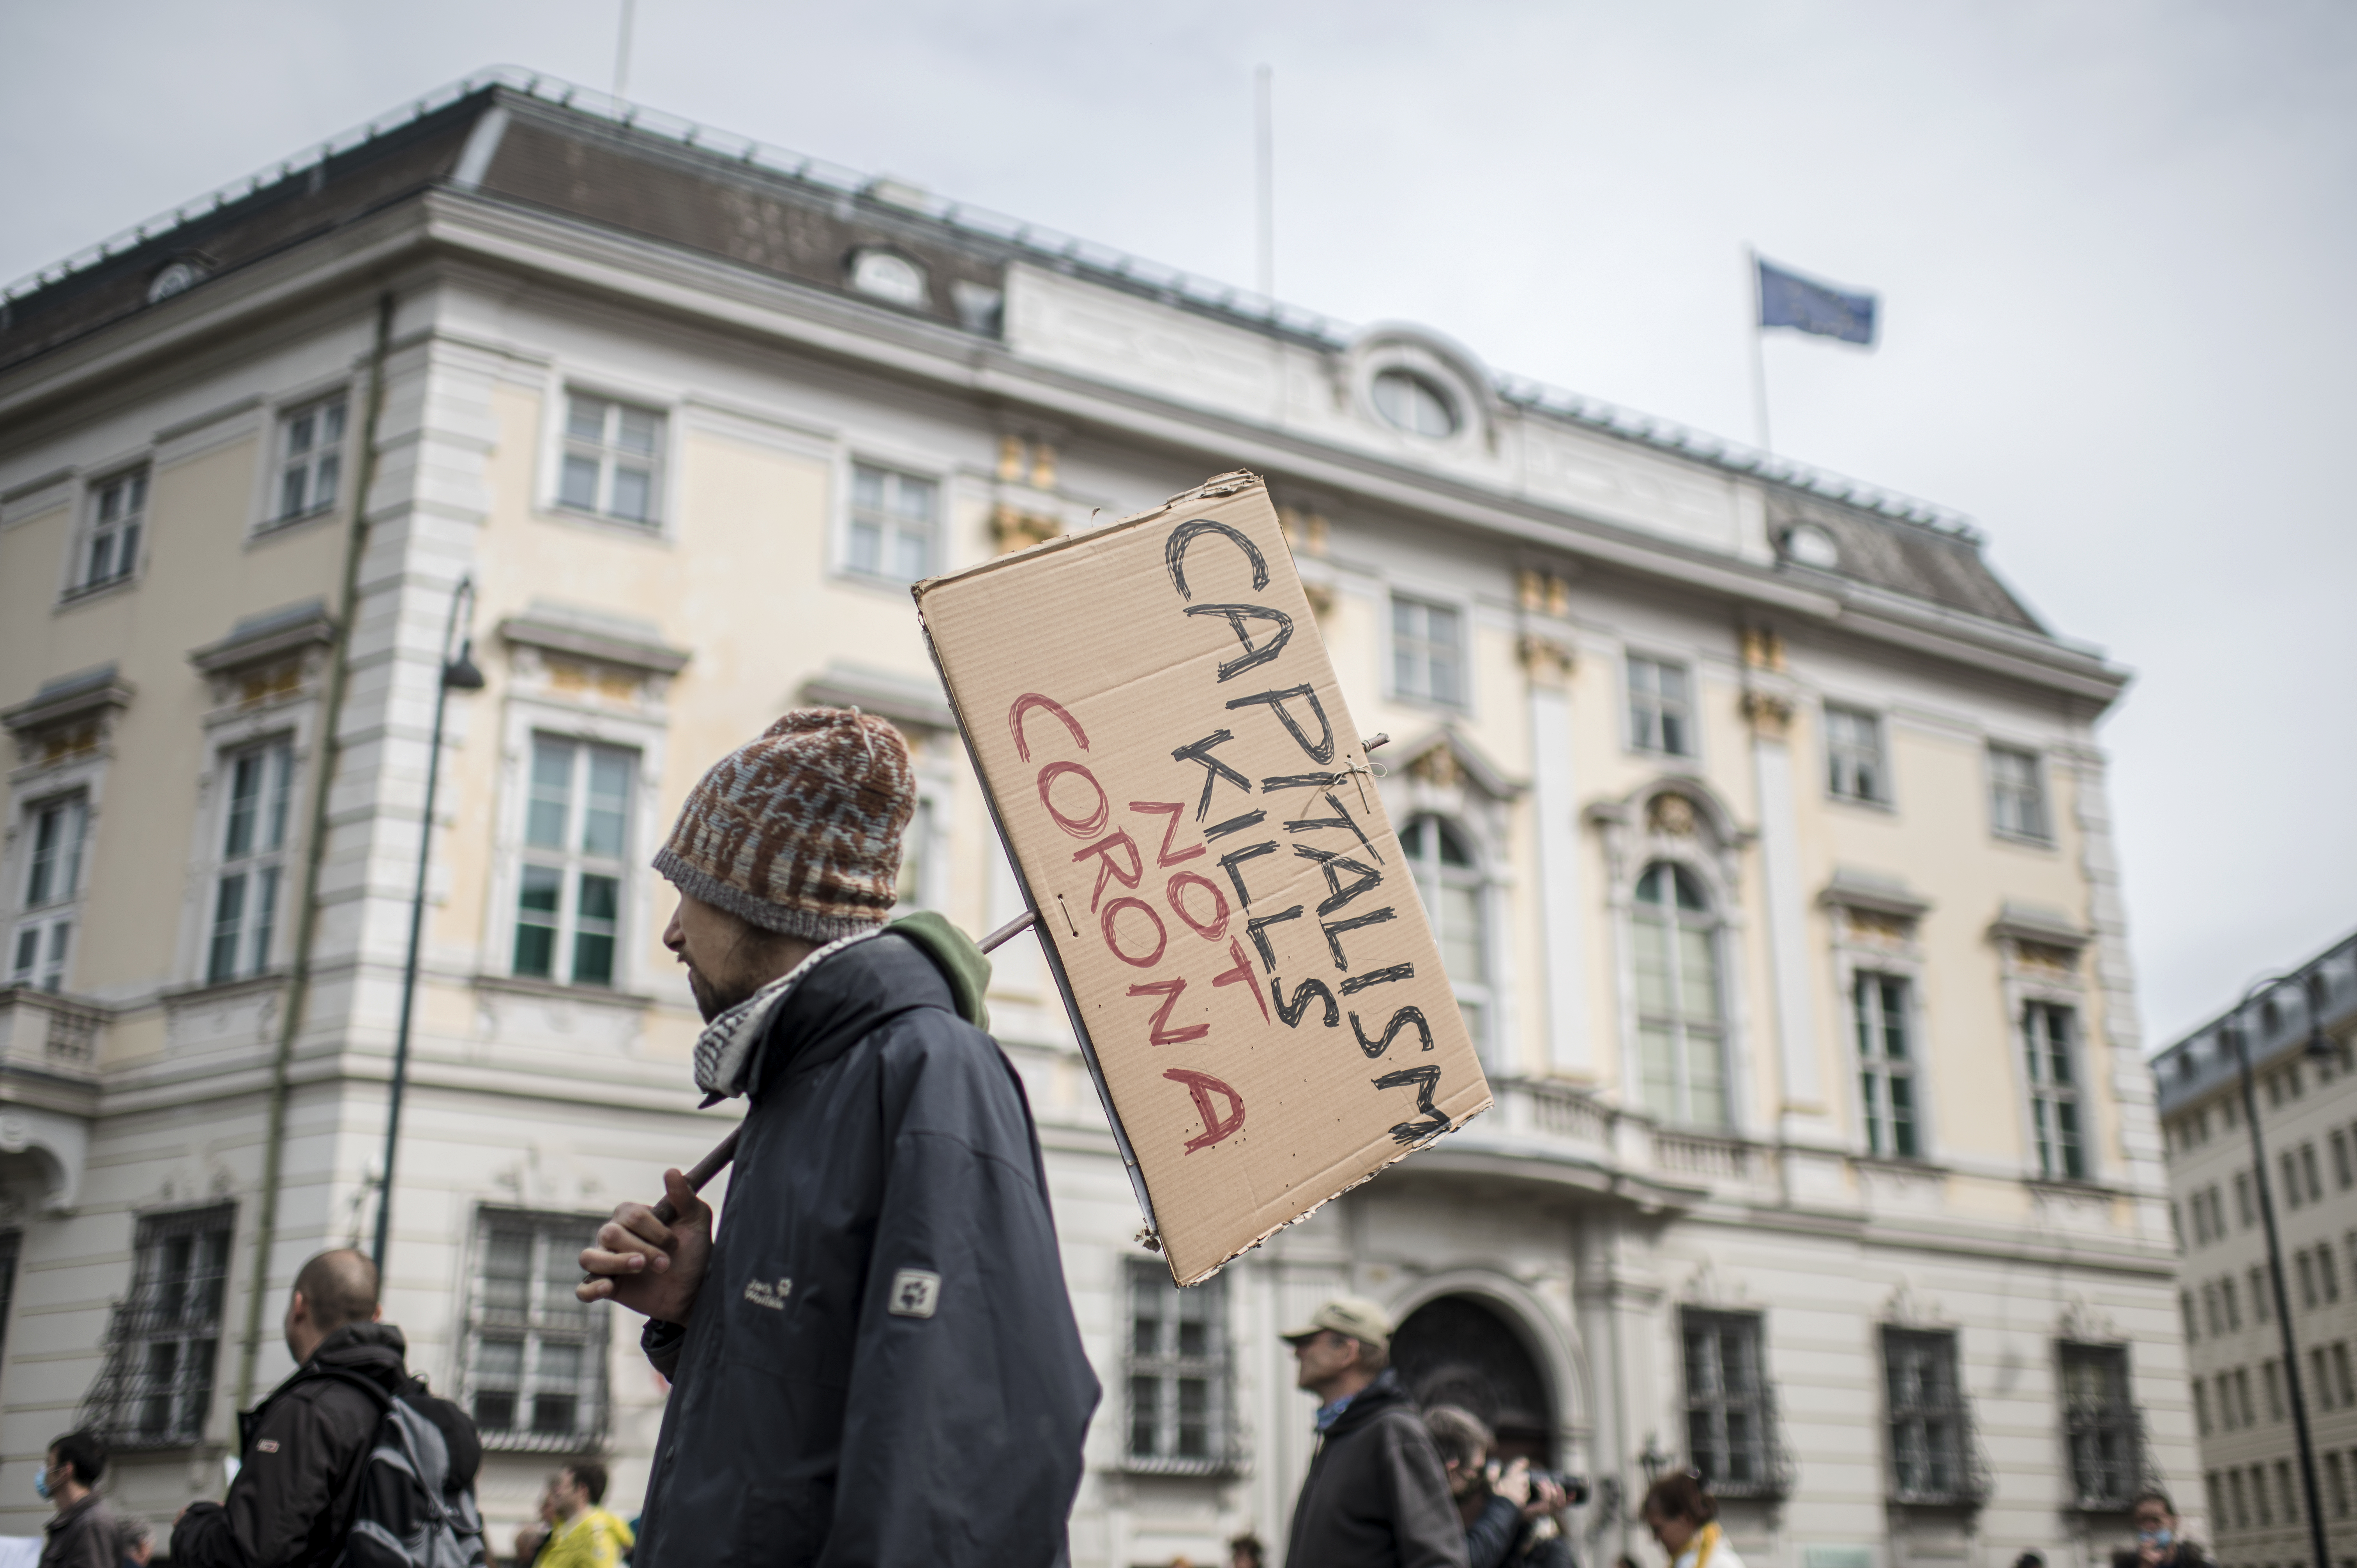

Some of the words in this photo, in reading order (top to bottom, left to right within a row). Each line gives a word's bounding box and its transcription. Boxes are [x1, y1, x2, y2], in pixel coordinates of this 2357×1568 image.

[1009, 693, 1246, 1157] CORONA
[1129, 801, 1270, 1025] NOT
[1165, 519, 1452, 1146] CAPITALISM
[1171, 729, 1339, 1028] KILLS
